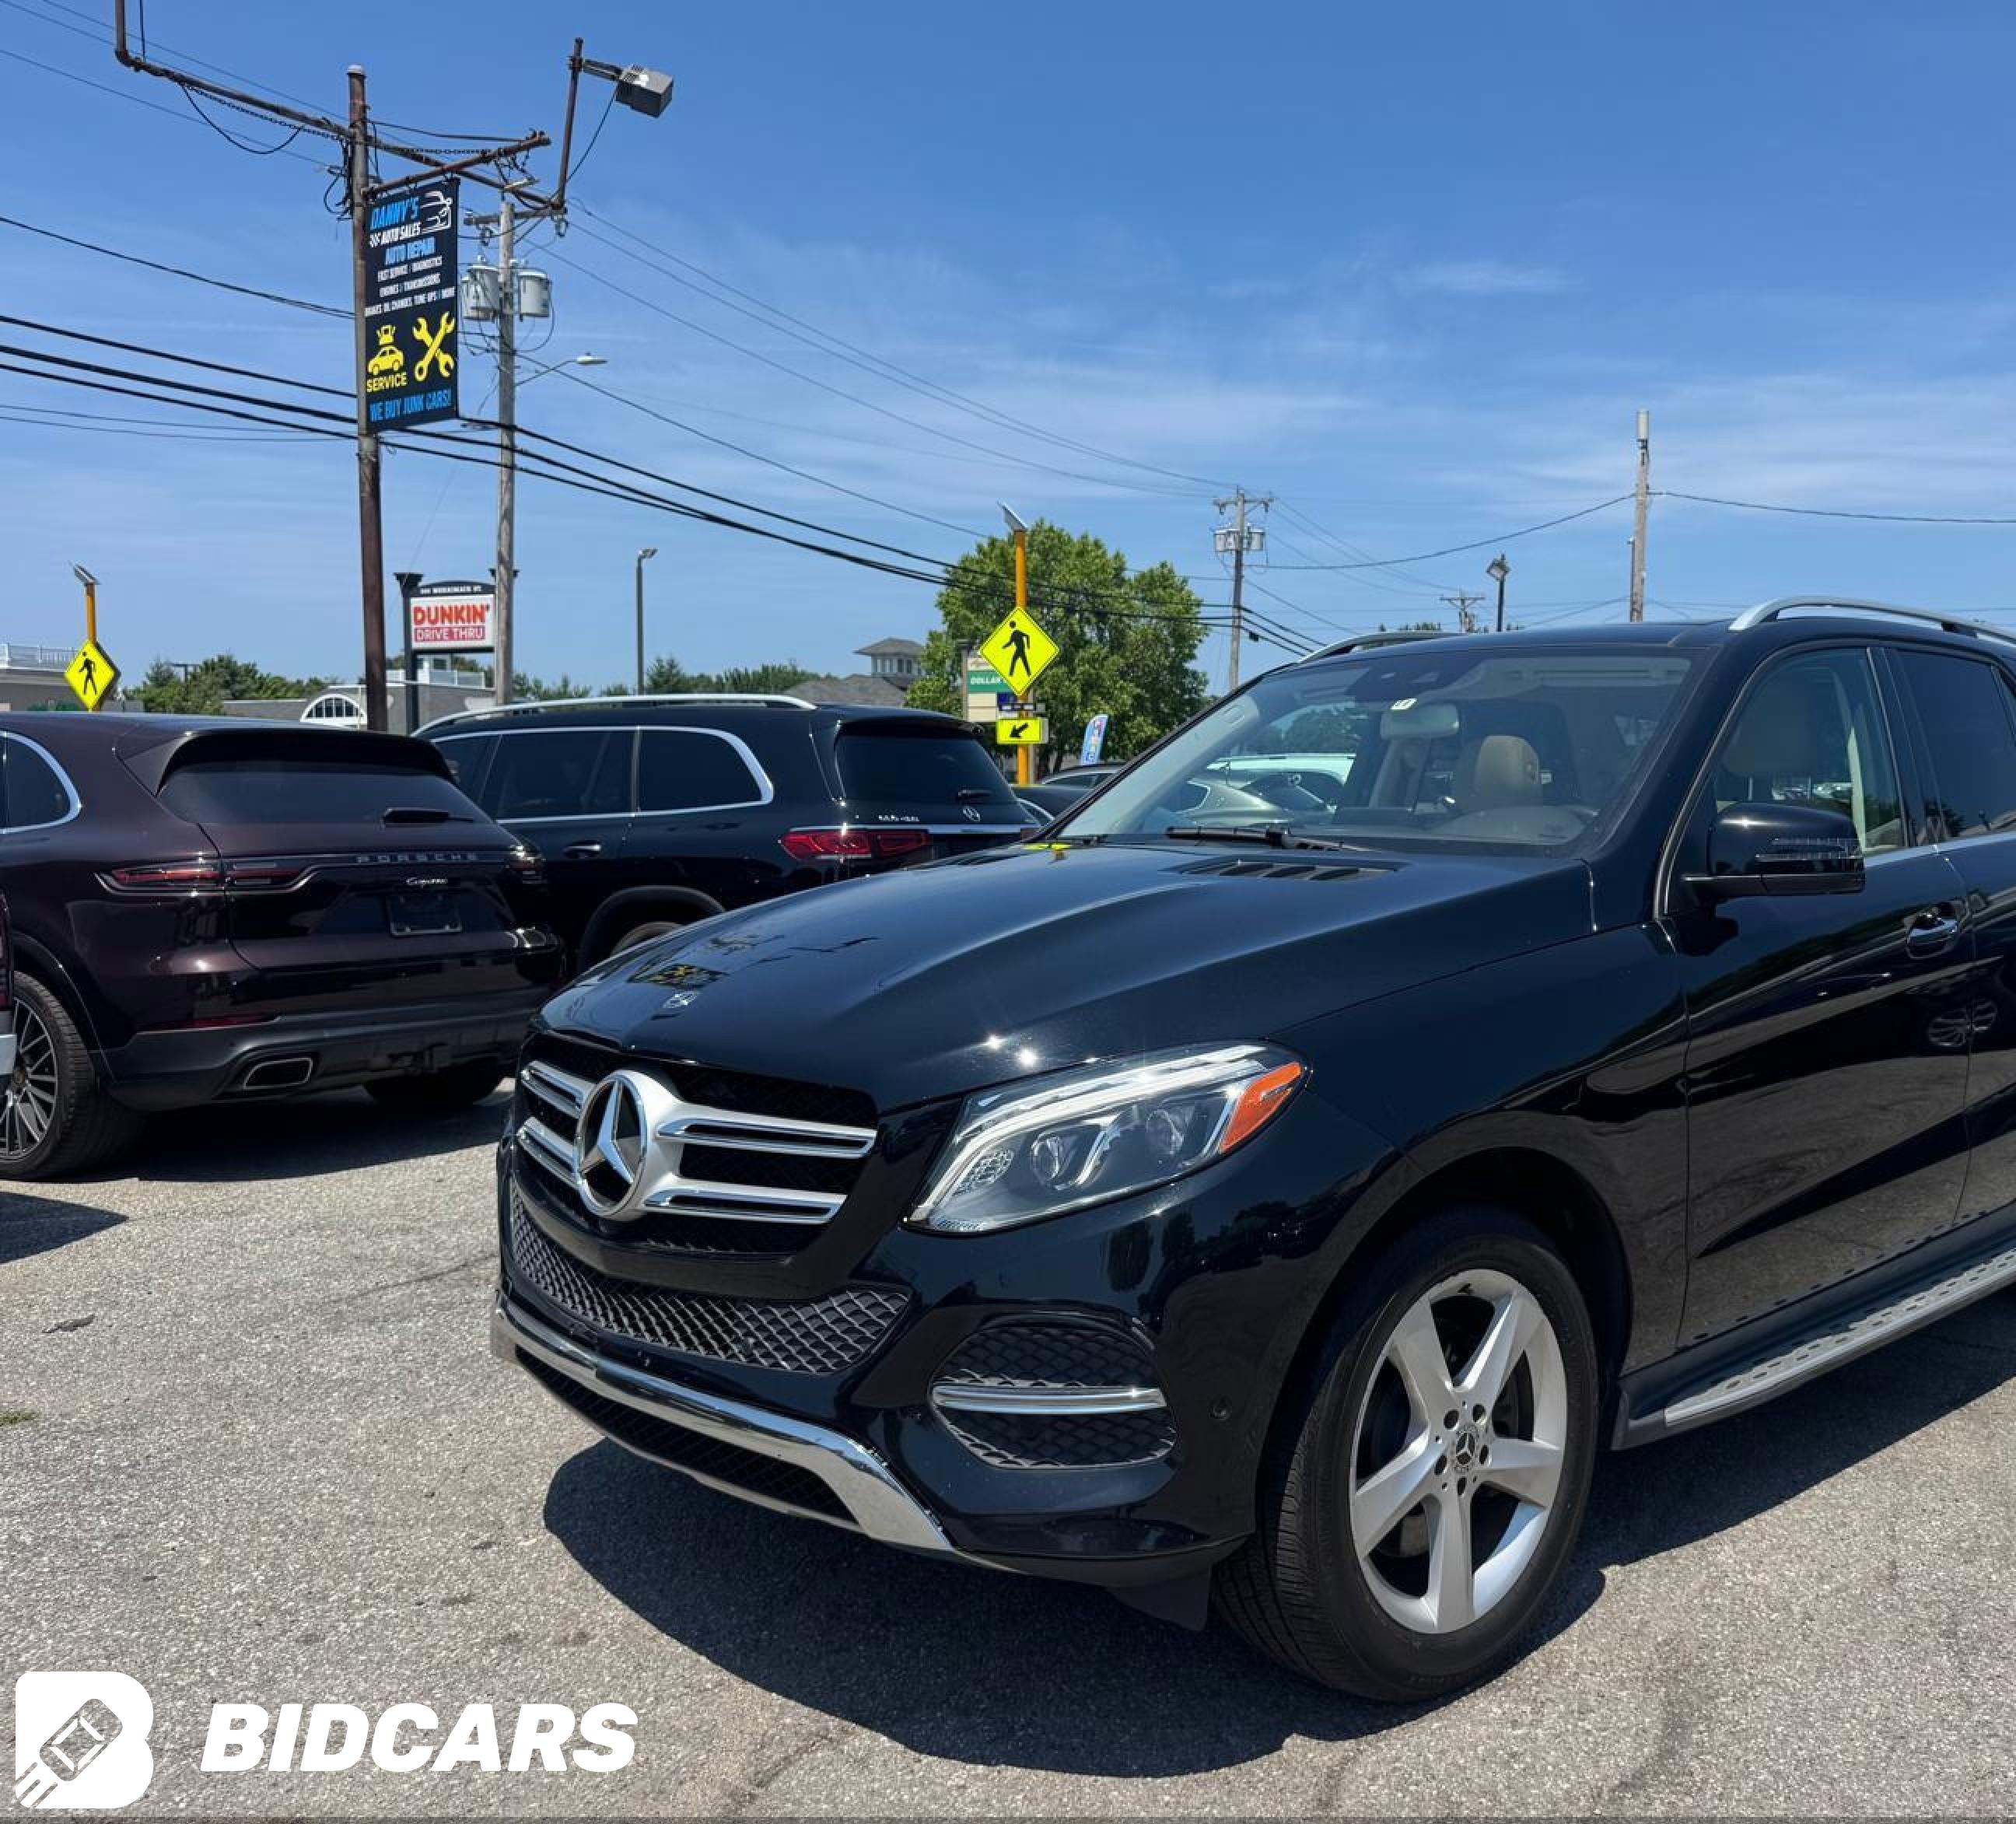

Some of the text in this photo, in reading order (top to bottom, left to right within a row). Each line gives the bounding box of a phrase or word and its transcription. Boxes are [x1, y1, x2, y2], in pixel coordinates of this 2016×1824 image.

[370, 197, 419, 231] DANNY'S
[381, 222, 422, 245] AUTO SALES
[366, 372, 408, 393] SERVICE
[369, 389, 451, 422] WE BUY JUNK CARS!
[413, 604, 490, 625] DUNKIN'
[416, 627, 483, 641] DRIVE THRU
[356, 852, 478, 863] PORSCHE
